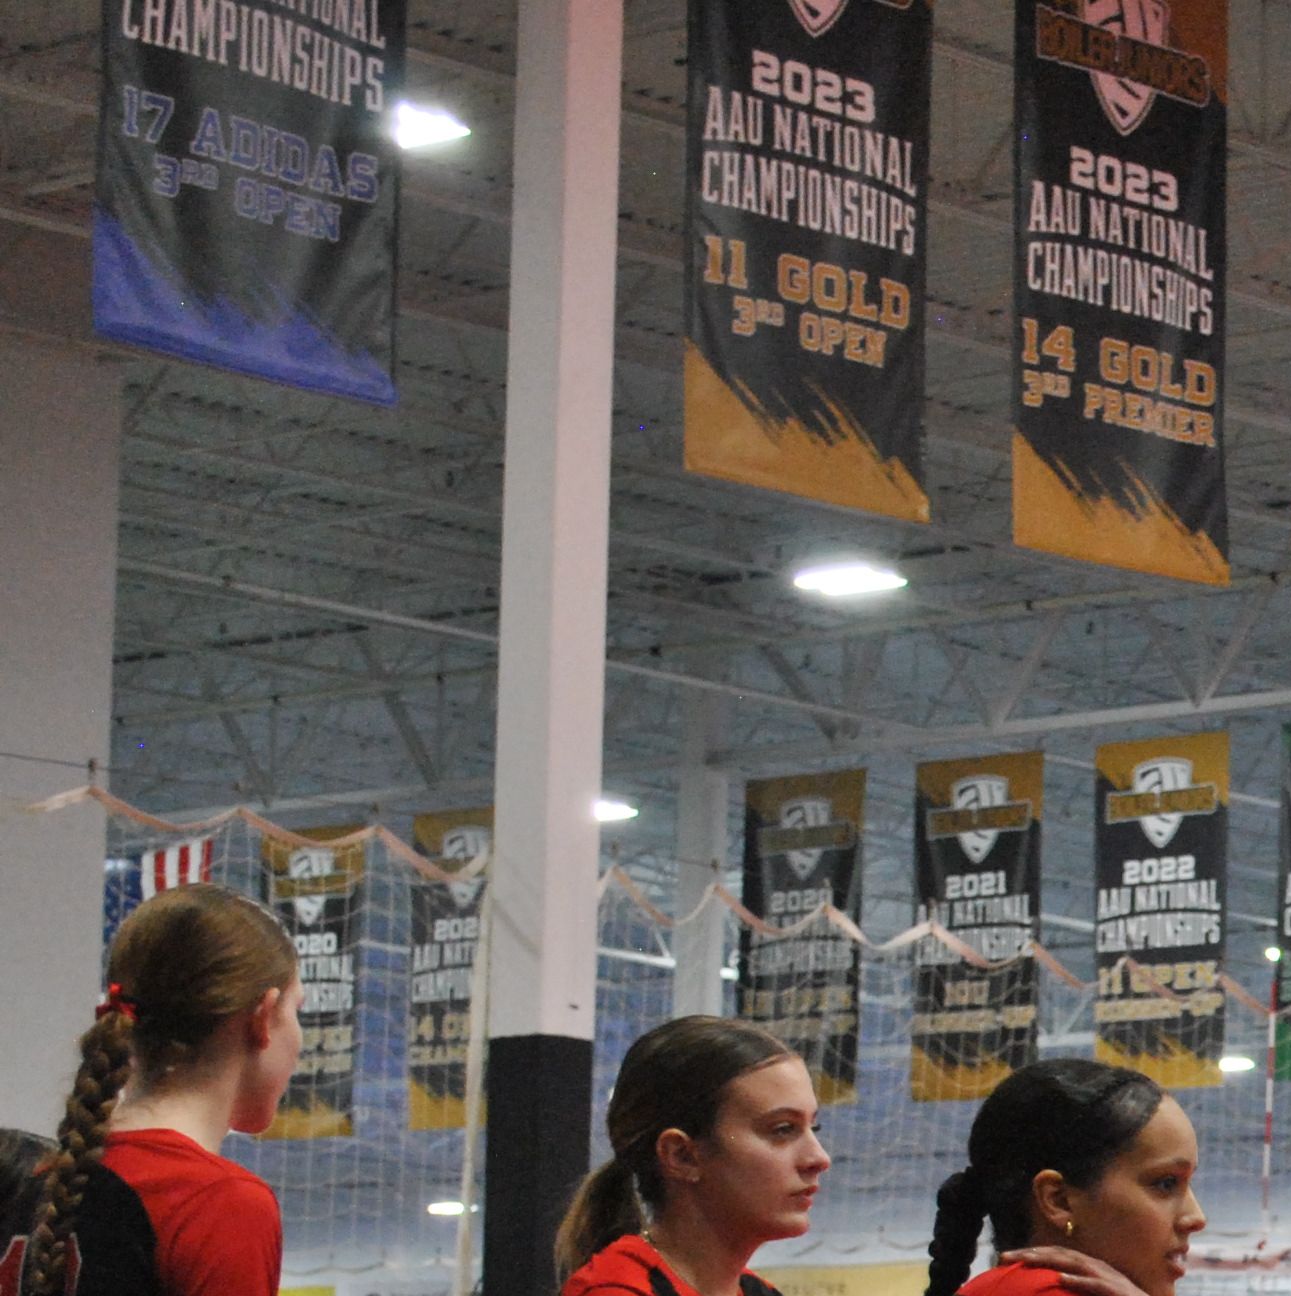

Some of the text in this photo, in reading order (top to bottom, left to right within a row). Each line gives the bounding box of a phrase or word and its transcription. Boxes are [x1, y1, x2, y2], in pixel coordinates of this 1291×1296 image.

[122, 0, 385, 112] CHAMPIONSHIPS
[752, 49, 876, 123] 2023
[122, 85, 379, 203] 17 ADIDAS
[704, 85, 917, 198] AAU NATIONAL
[1070, 145, 1178, 212] 2023
[233, 177, 341, 242] OPEN
[702, 151, 916, 256] CHAMPIONSHIPS
[1028, 180, 1214, 280] AAU NATIONAL
[704, 235, 911, 330] 11 GOLD
[1027, 241, 1213, 335] CHAMPIONSHIPS
[799, 312, 887, 368] OPEN
[1022, 317, 1217, 407] 14 GOLD
[1084, 382, 1215, 447] PREMIER
[946, 872, 1006, 900] 2021
[1123, 855, 1195, 885] 2022
[1134, 879, 1221, 912] NATIONAL
[295, 932, 337, 956] 020
